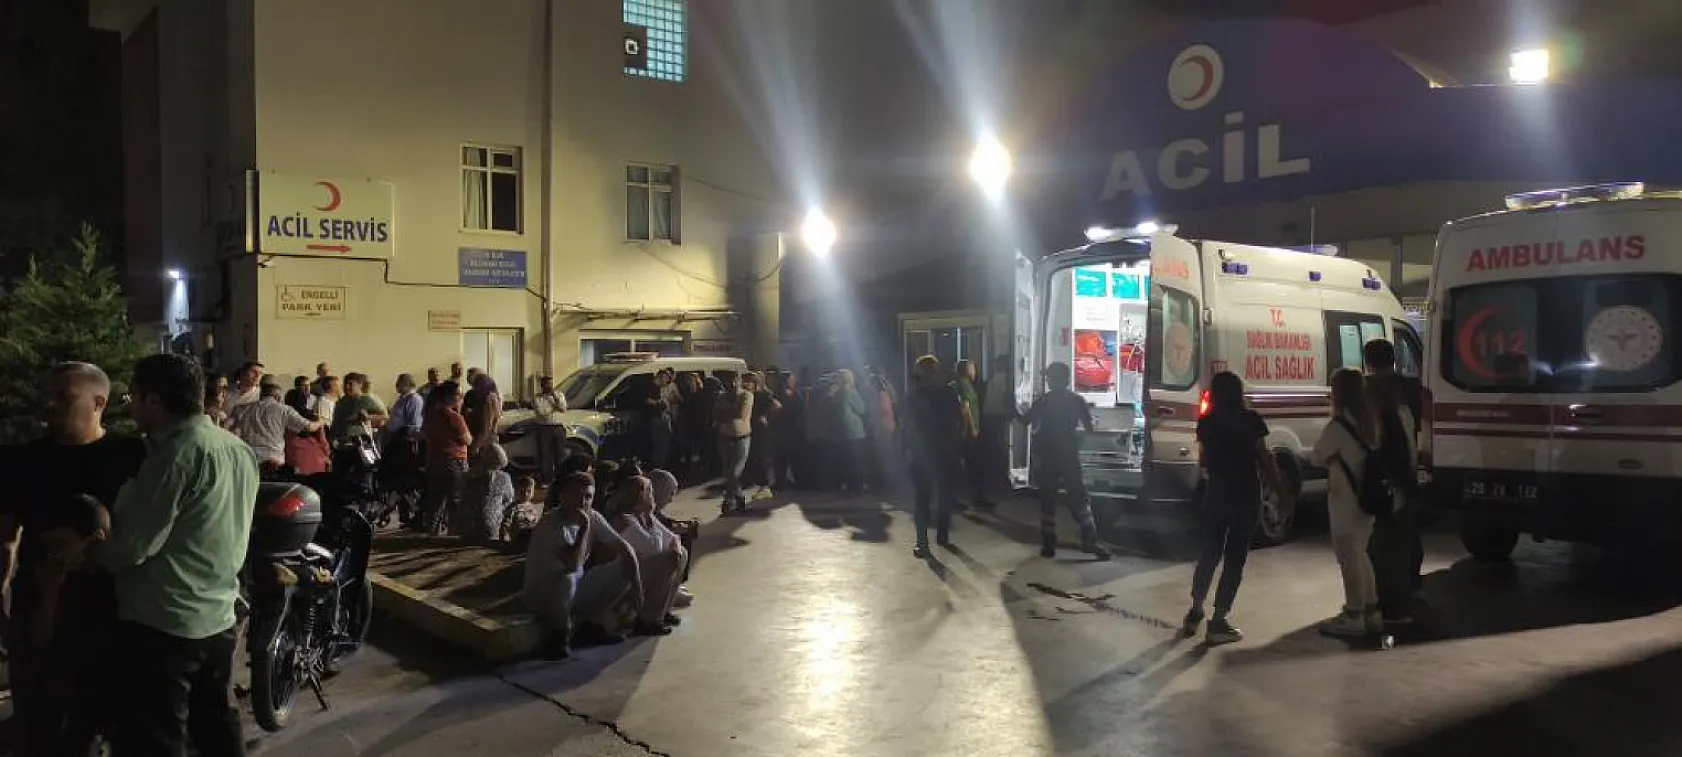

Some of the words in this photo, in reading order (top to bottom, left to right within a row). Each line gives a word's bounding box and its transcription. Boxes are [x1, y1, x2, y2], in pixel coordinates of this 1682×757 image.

[1100, 111, 1311, 202] ACİL
[267, 211, 314, 239] ACİL
[319, 217, 388, 243] SERVİS
[1465, 234, 1647, 272] AMBULANS
